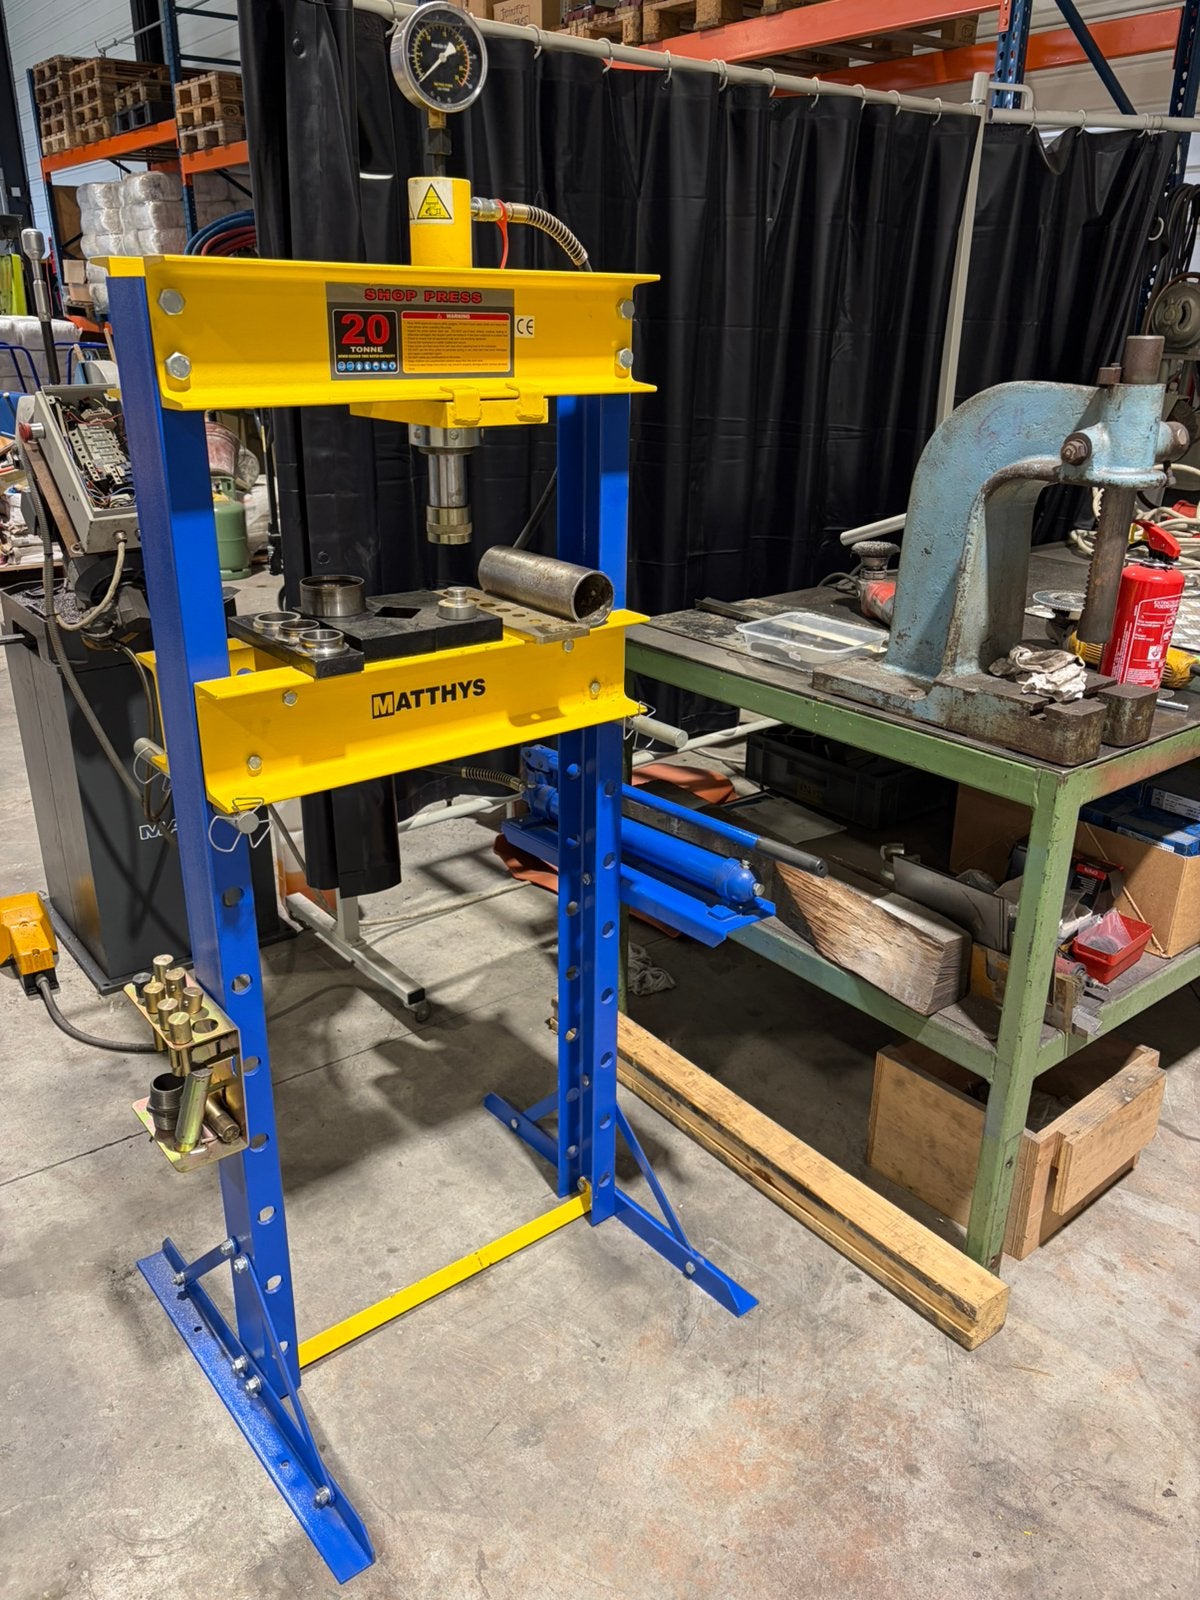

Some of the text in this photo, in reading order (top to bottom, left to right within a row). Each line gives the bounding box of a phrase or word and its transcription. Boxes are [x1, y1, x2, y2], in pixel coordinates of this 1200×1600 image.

[364, 288, 482, 303] SHOP PRESS
[341, 313, 390, 345] 20
[516, 318, 534, 335] CE
[371, 678, 486, 719] MATTHYS
